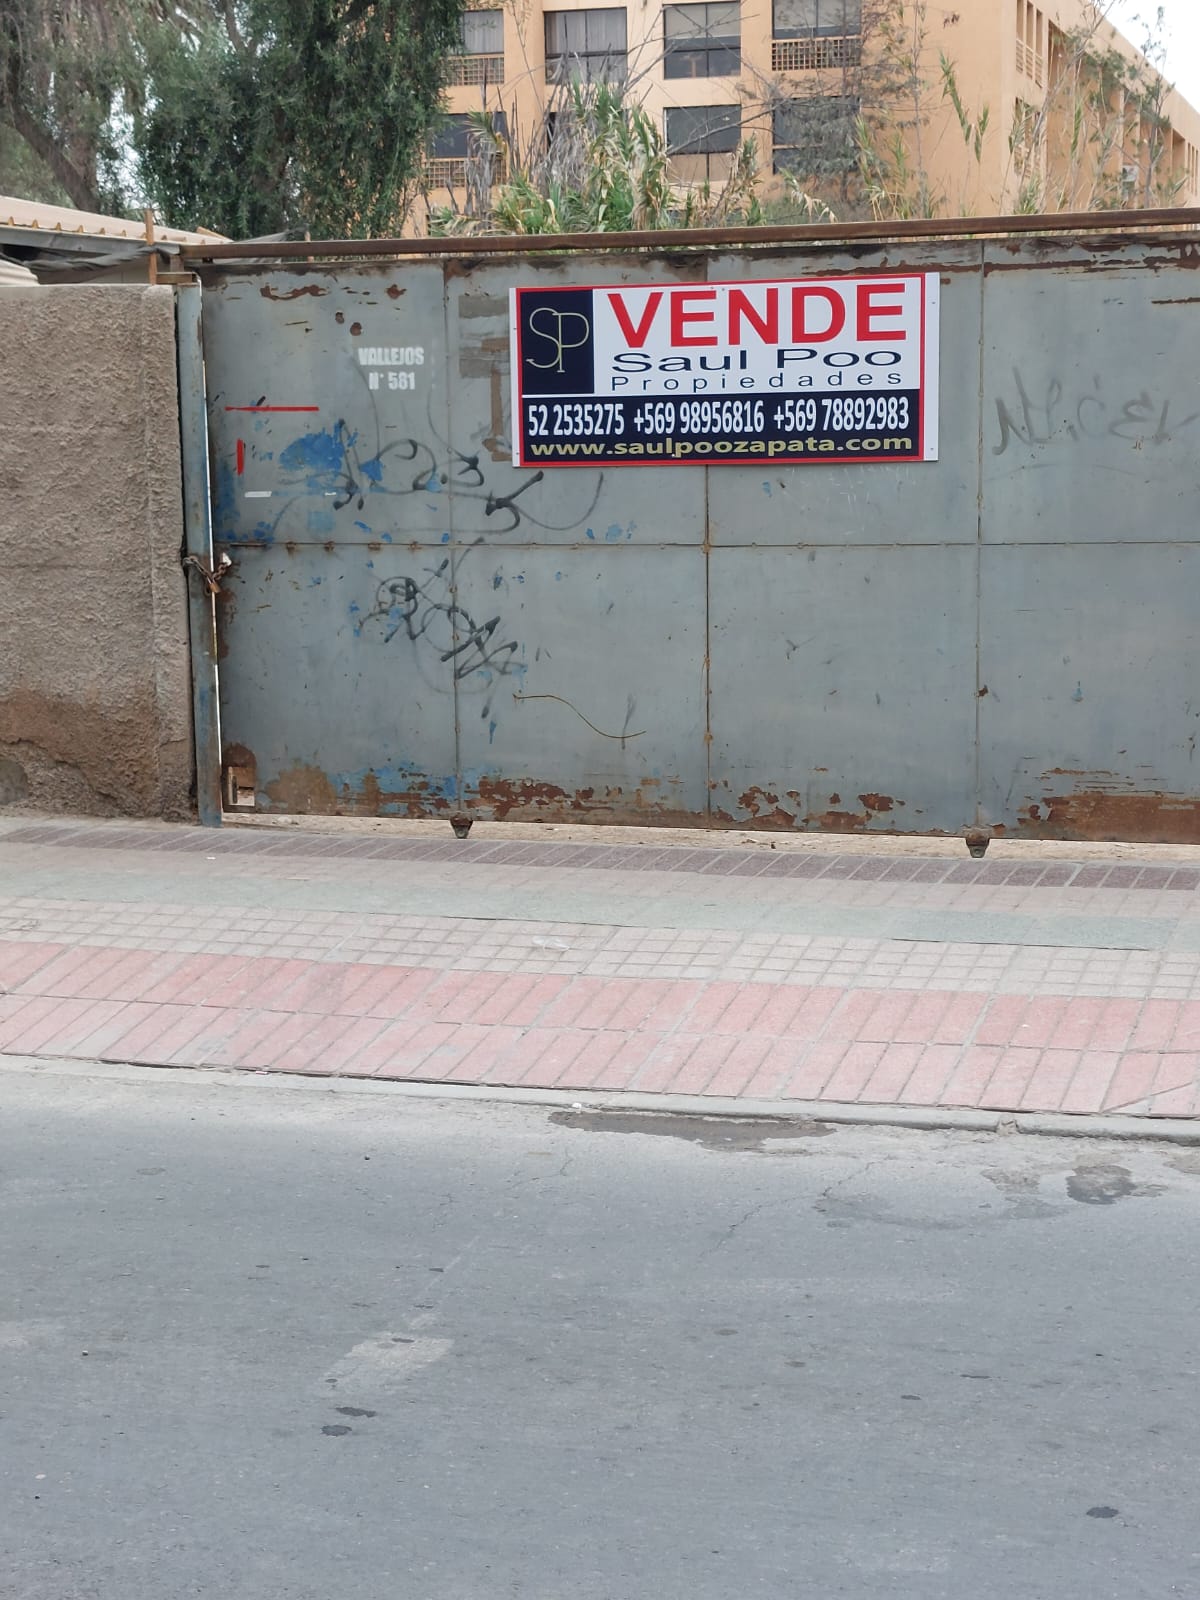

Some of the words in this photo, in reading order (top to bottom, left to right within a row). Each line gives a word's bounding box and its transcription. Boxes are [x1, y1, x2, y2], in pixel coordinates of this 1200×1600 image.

[607, 283, 907, 348] VENDE
[358, 347, 425, 366] VALLEJOS
[611, 350, 747, 373] Saul
[777, 348, 902, 369] Poo
[388, 371, 416, 390] 581
[612, 371, 902, 392] Propiedades
[528, 404, 549, 437] 52
[553, 403, 625, 436] 2535275
[633, 401, 676, 434] +569
[680, 400, 765, 434] 98956816
[773, 398, 817, 432] +569
[821, 396, 910, 431] 78892983
[530, 436, 913, 458] www.saulpoozapata.com
